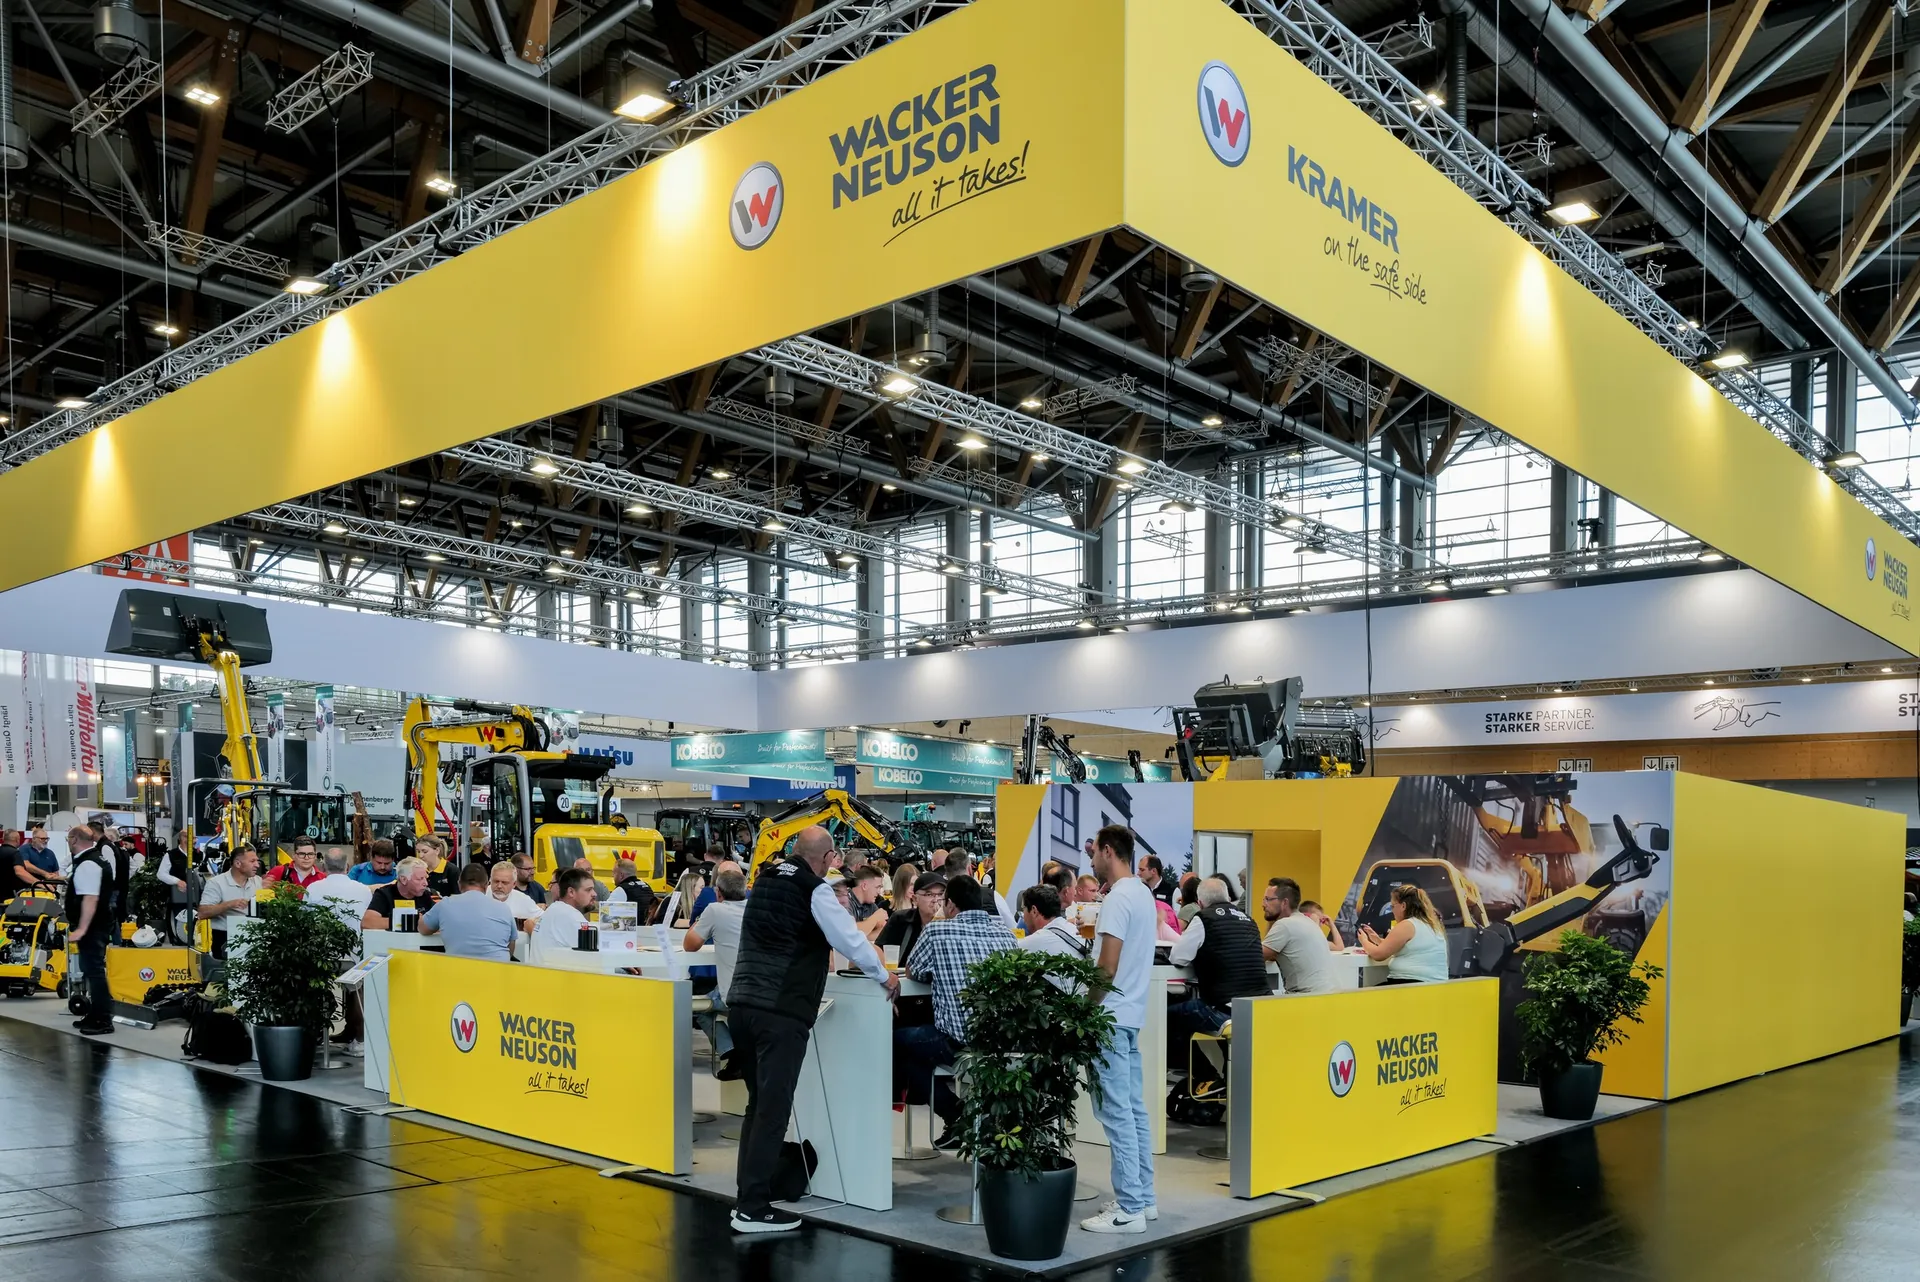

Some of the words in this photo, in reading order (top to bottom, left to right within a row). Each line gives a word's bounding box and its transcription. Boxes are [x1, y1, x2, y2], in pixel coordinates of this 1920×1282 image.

[829, 63, 1000, 167] WACKER
[832, 103, 1000, 210] NEUSON
[892, 190, 922, 228] all
[930, 174, 955, 210] it
[955, 140, 1030, 198] takes!
[1288, 144, 1400, 255] KRAMER
[1323, 236, 1343, 261] on
[1347, 235, 1370, 272] the
[1373, 259, 1400, 301] safe
[1403, 272, 1427, 305] side
[1883, 550, 1908, 583] WACKER
[1883, 569, 1908, 600] NEUSON
[1485, 711, 1533, 722] STARKE
[1536, 708, 1595, 720] PARTNER.
[1485, 722, 1540, 733] STARKER
[1543, 720, 1594, 731] SERVICE.
[76, 690, 97, 774] Mitteltal
[676, 742, 726, 760] KOBELCO
[862, 738, 919, 761] KOBELCO
[878, 767, 923, 784] KOBELCO
[560, 797, 570, 809] 20
[308, 827, 317, 836] 20
[499, 1011, 577, 1046] WACKER
[500, 1035, 577, 1071] NEUSON
[1376, 1031, 1439, 1061] WACKER
[528, 1071, 542, 1089] all
[545, 1071, 557, 1088] it
[557, 1075, 590, 1096] takes!
[1377, 1054, 1439, 1086] NEUSON
[1400, 1087, 1412, 1106] all
[1414, 1084, 1423, 1102] it
[1422, 1077, 1448, 1098] takes!
